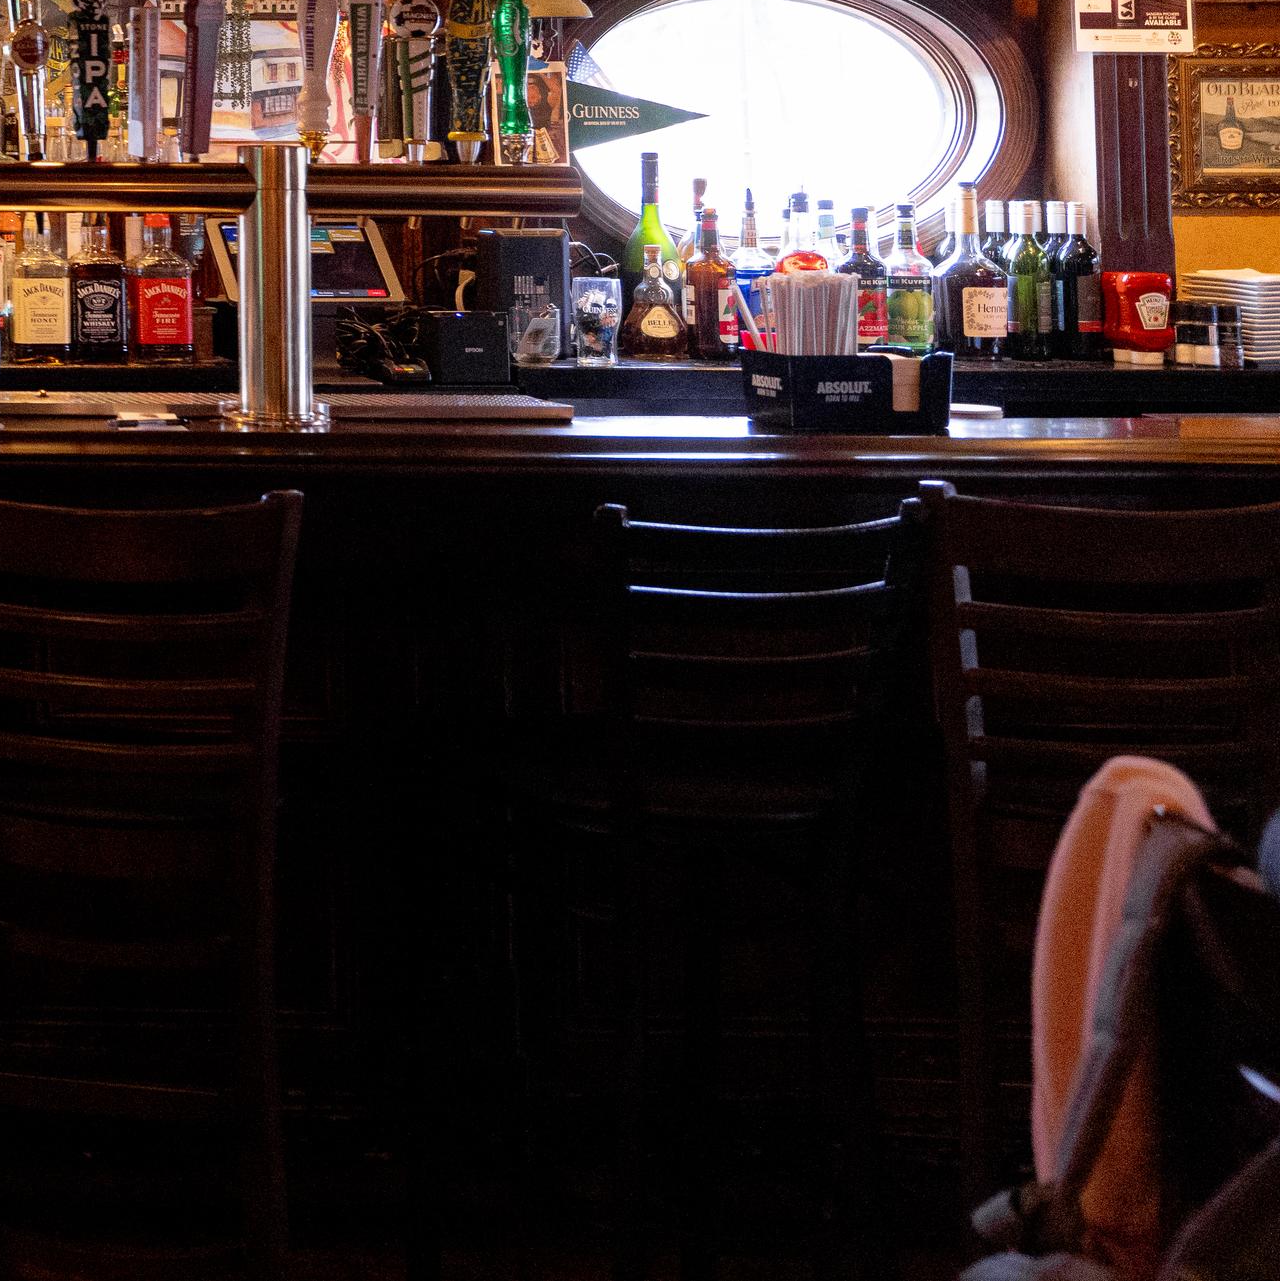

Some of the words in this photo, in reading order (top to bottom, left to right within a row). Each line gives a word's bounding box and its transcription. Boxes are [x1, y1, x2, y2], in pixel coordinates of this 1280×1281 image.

[81, 23, 109, 31] STONE
[356, 6, 367, 53] WINTER
[357, 56, 367, 94] WHITE
[1207, 82, 1237, 97] OLD
[572, 104, 641, 120] GUINNESS
[23, 286, 40, 298] JACK
[40, 282, 65, 297] DANIEL'S
[77, 285, 95, 299] JACK
[95, 282, 121, 297] DANIEL'S
[144, 286, 162, 299] JACK
[162, 282, 188, 298] DANIEL'S
[582, 306, 617, 314] GUINNESS
